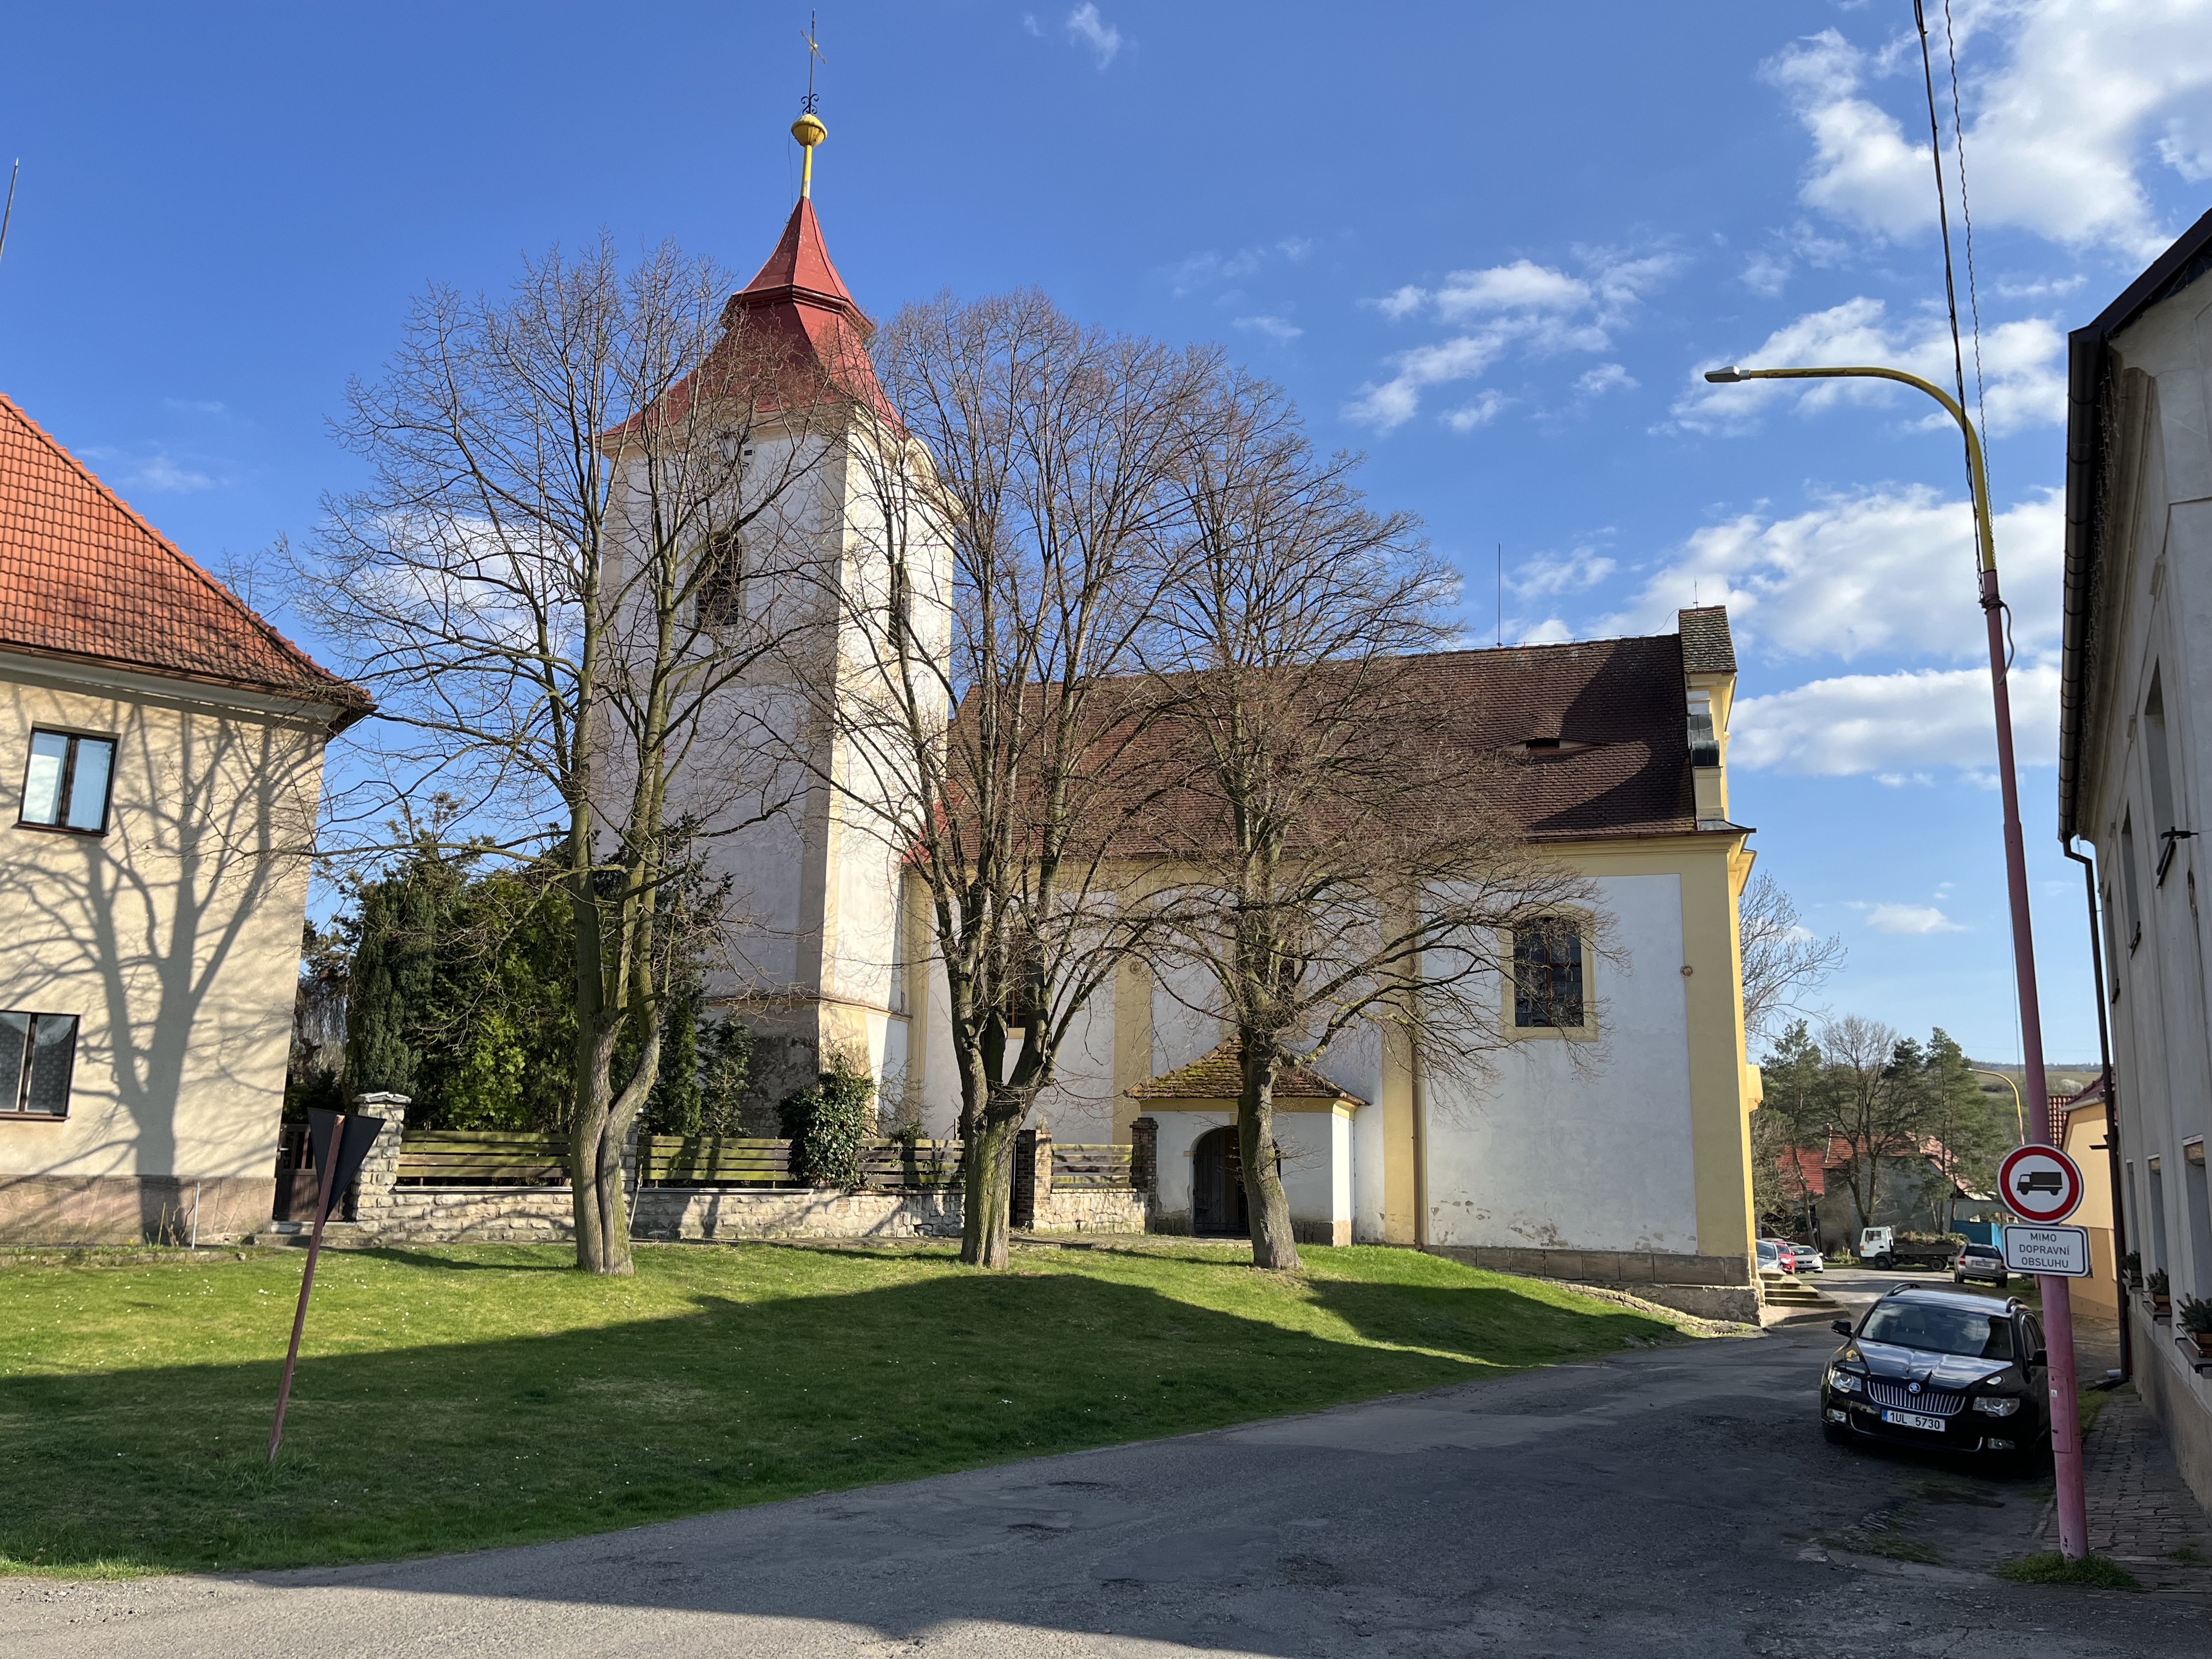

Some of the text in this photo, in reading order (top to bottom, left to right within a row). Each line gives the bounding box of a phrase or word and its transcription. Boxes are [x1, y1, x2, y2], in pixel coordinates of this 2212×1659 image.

[2030, 1232, 2057, 1242] MIMO
[2019, 1244, 2070, 1255] DOPRAVNÍ
[2021, 1257, 2069, 1268] OBSLUHU
[1890, 1412, 1940, 1429] 1UL 5730
